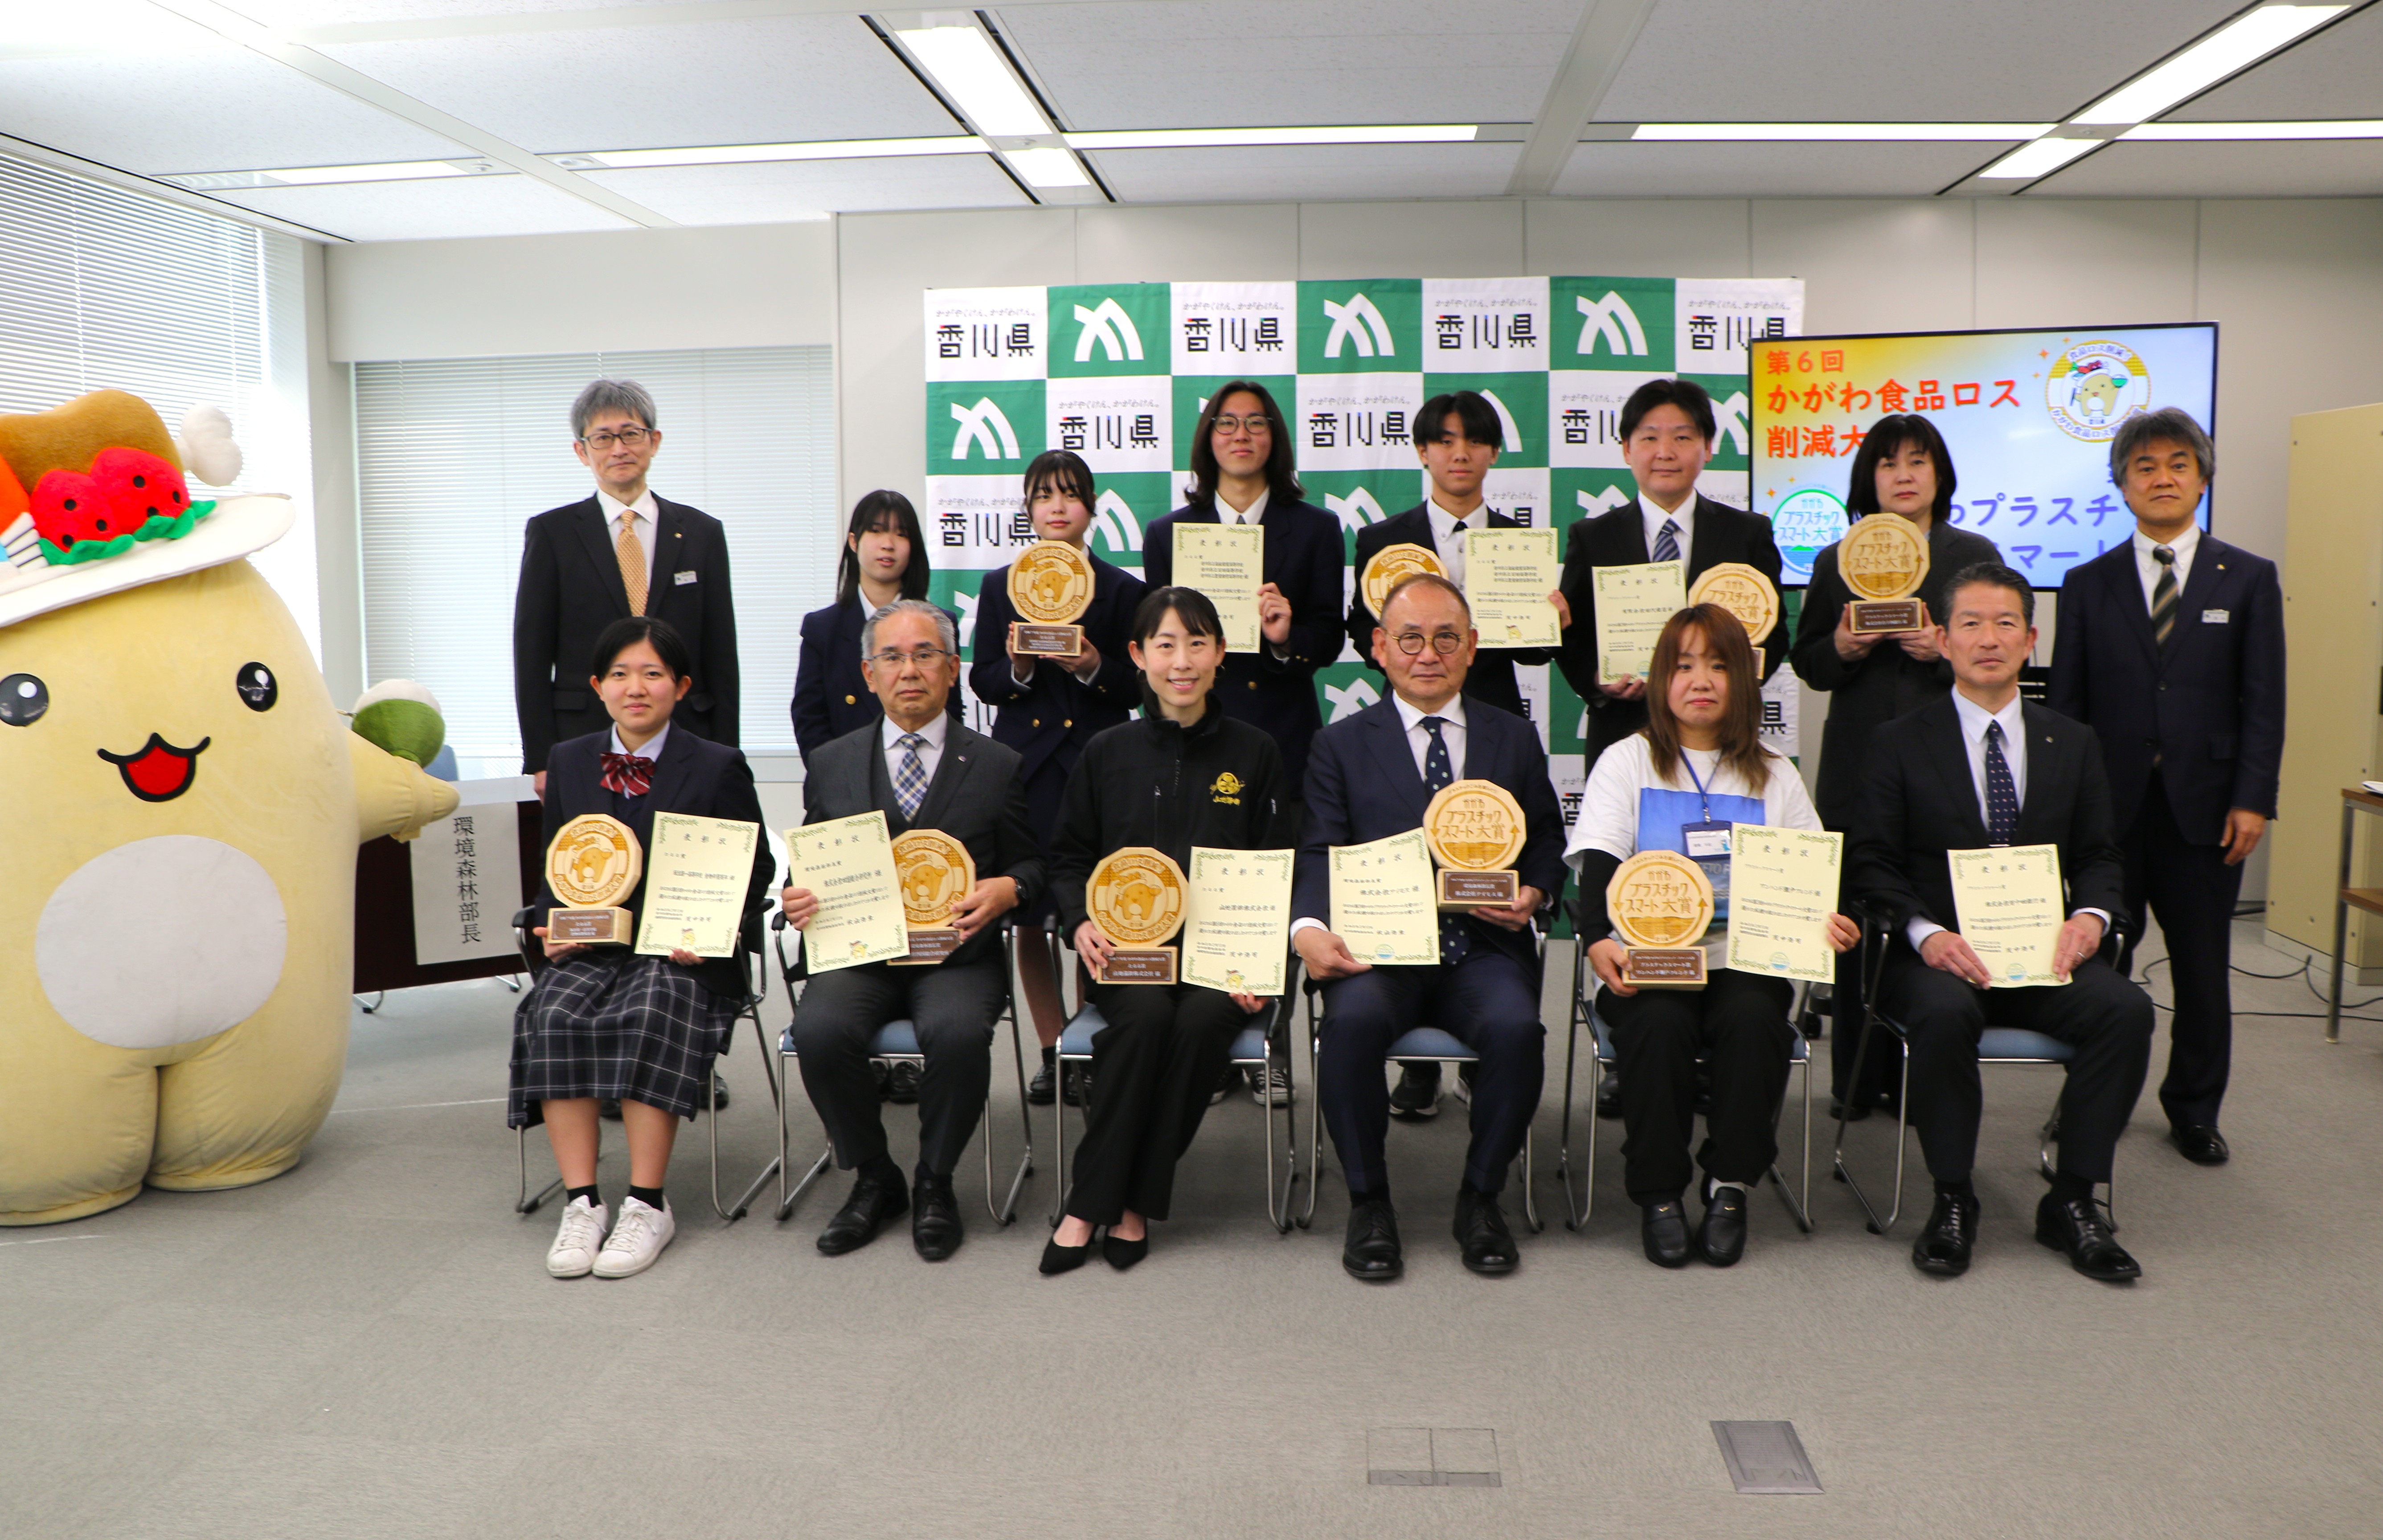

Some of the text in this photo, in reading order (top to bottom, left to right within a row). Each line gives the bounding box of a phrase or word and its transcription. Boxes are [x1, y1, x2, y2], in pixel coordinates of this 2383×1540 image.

[937, 324, 1034, 358] 香川県
[1184, 317, 1283, 352] 香川県
[1435, 314, 1537, 348] 香川県
[1766, 350, 1844, 375] 第6回
[1767, 379, 2020, 414] かがわ食品ロス
[1059, 415, 1159, 450] 香川県
[1309, 412, 1410, 447] 香川県
[1562, 410, 1622, 444] 香川
[939, 513, 1040, 546] 香川県
[1784, 511, 1839, 525] プラスチック
[1709, 590, 1759, 604] プラスチック
[1441, 823, 1505, 840] スマート大賞
[1446, 811, 1502, 824] プラスチック
[453, 816, 482, 944] 環境森林部長
[1630, 883, 1688, 897] プラスチック
[1626, 896, 1693, 913] スマート大賞
